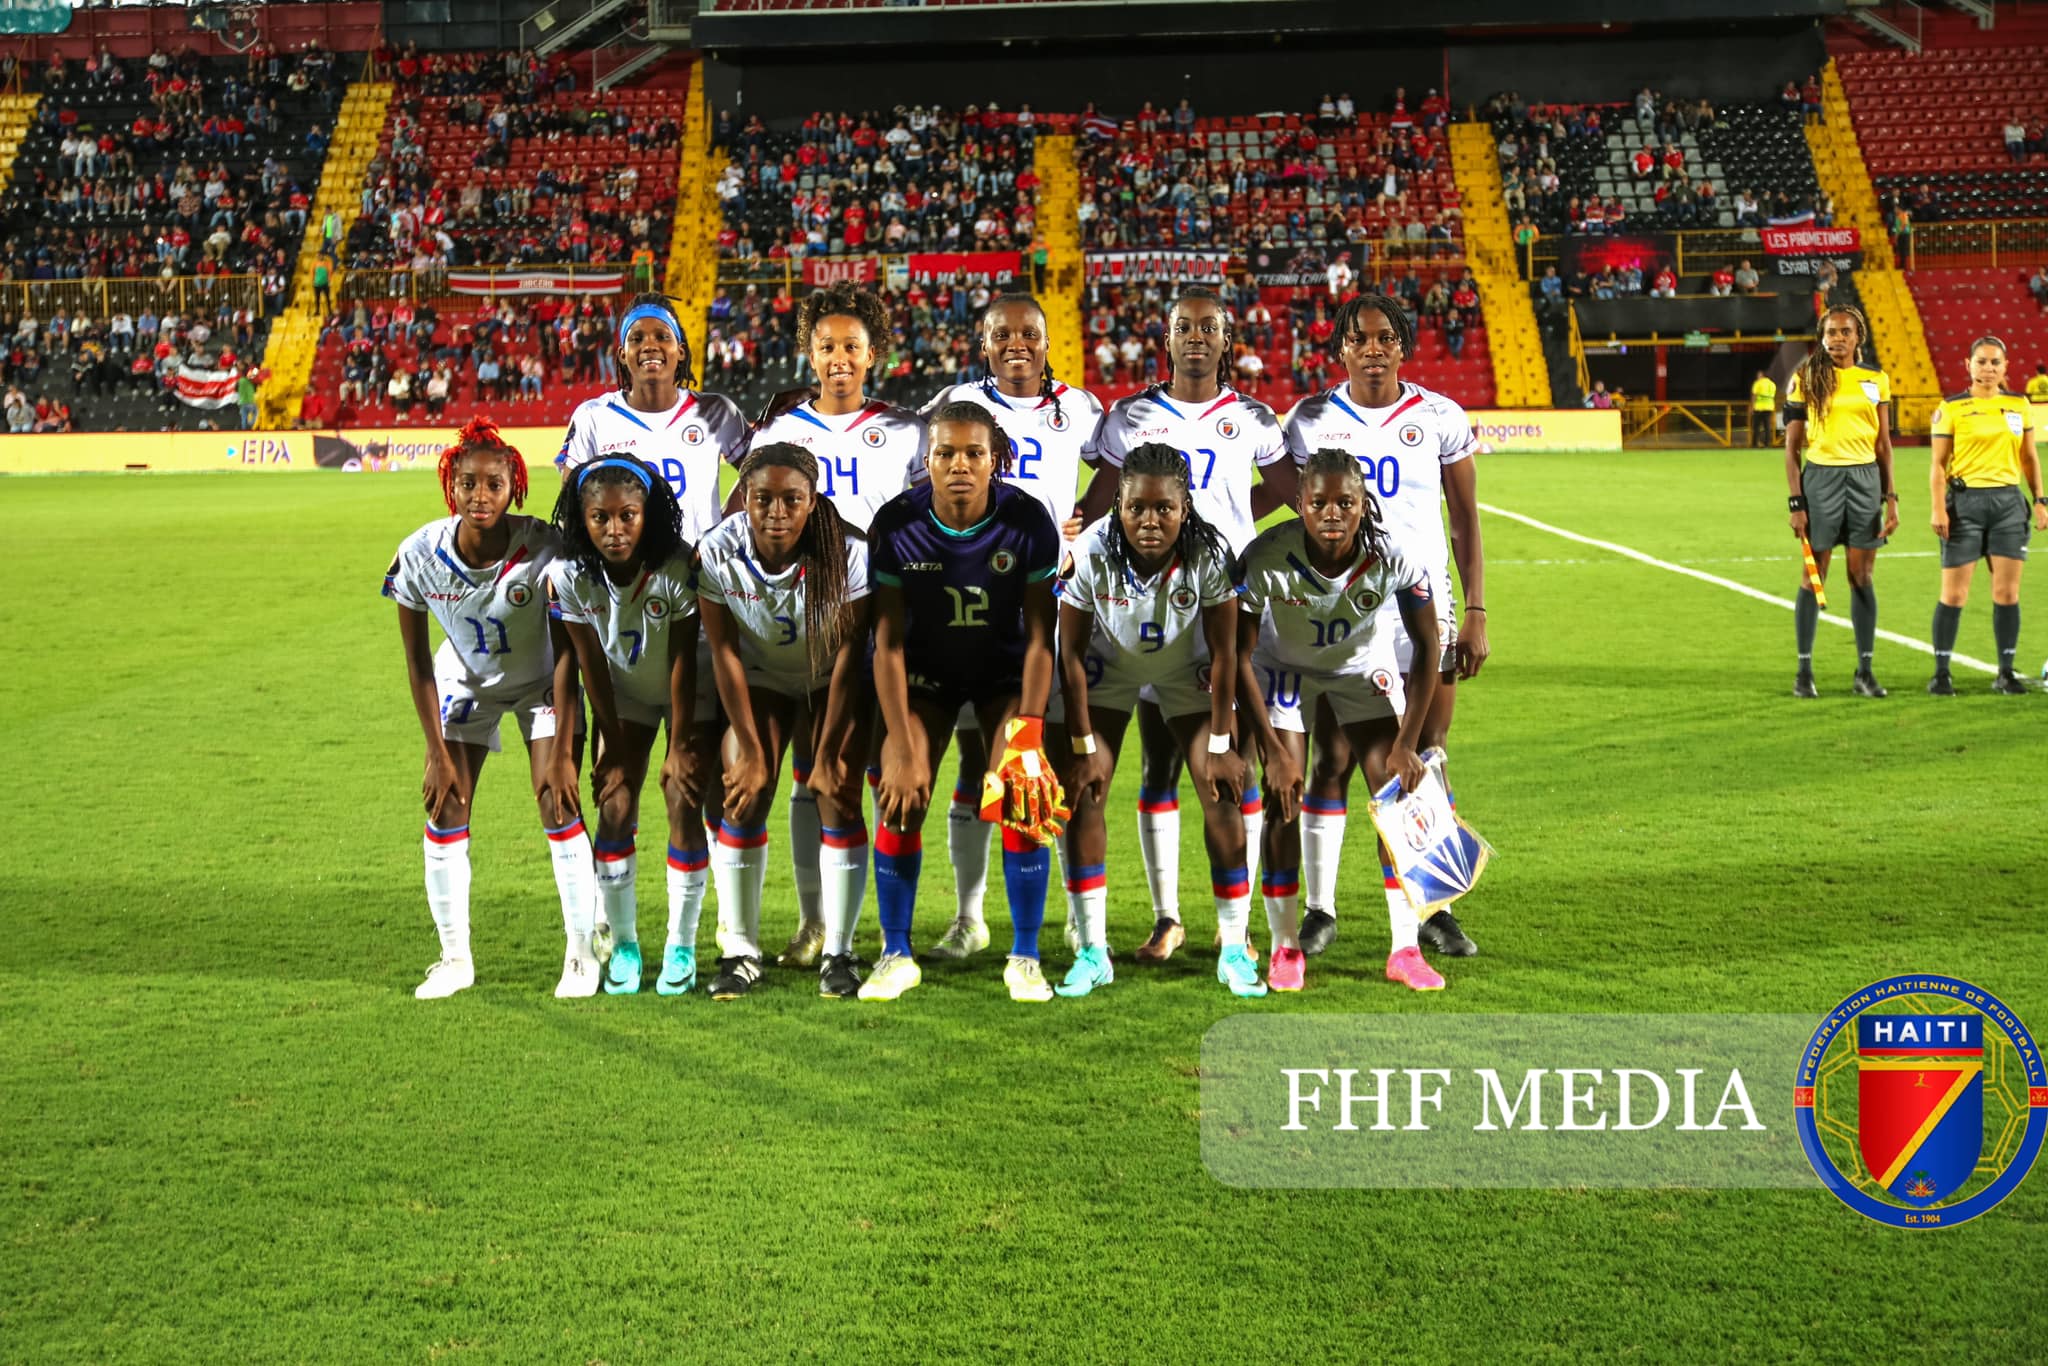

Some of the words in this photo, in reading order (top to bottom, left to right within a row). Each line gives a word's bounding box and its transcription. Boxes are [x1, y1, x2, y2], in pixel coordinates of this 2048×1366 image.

[1767, 233, 1788, 248] LES
[1789, 231, 1854, 247] PROMETIMOS
[814, 262, 868, 288] DALE
[936, 271, 990, 287] MAADA
[1475, 418, 1543, 443] hogares
[241, 440, 291, 463] EPA
[600, 440, 637, 452] SAETA
[817, 456, 858, 496] 14
[904, 561, 943, 571] SAETA
[424, 592, 460, 602] SAETA
[725, 589, 760, 602] SAETA
[943, 586, 990, 626] 12
[465, 616, 511, 654] 11
[774, 616, 798, 646] 3
[1140, 622, 1164, 653] 9
[1308, 618, 1350, 647] 10
[619, 630, 641, 665] 7
[1263, 667, 1301, 708] 10
